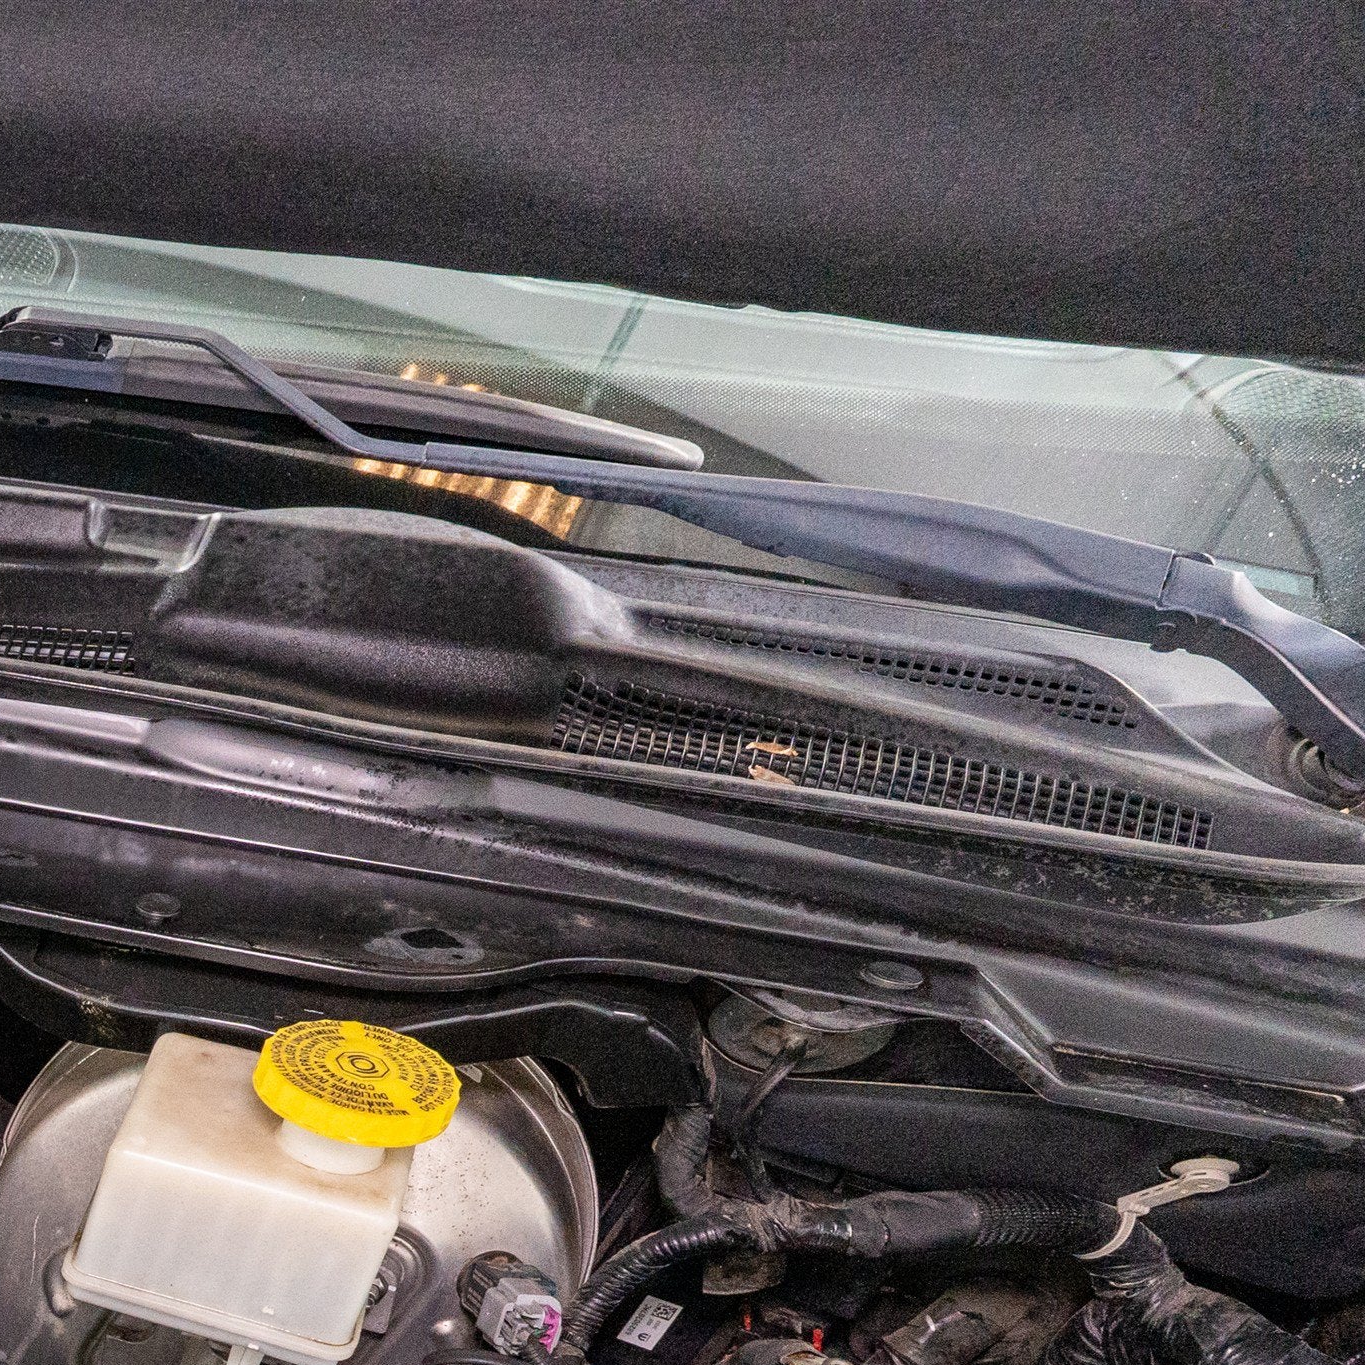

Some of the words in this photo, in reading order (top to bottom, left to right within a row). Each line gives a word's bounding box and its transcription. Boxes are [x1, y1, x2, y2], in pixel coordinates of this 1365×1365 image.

[282, 1020, 343, 1035] REMPLISSAGE
[363, 1023, 420, 1047] CONTAINER
[363, 1030, 394, 1043] ONLY
[415, 1045, 446, 1065] SEALED
[308, 1071, 331, 1084] DOT
[315, 1060, 377, 1091] CONTENANT
[280, 1071, 326, 1100] NETTOYER
[327, 1081, 372, 1099] LIQUIDE
[326, 1089, 342, 1099] LE
[341, 1094, 358, 1104] DE
[371, 1092, 390, 1100] DU
[360, 1098, 396, 1108] AVANT
[417, 1101, 440, 1112] DOT
[367, 1107, 384, 1115] EN
